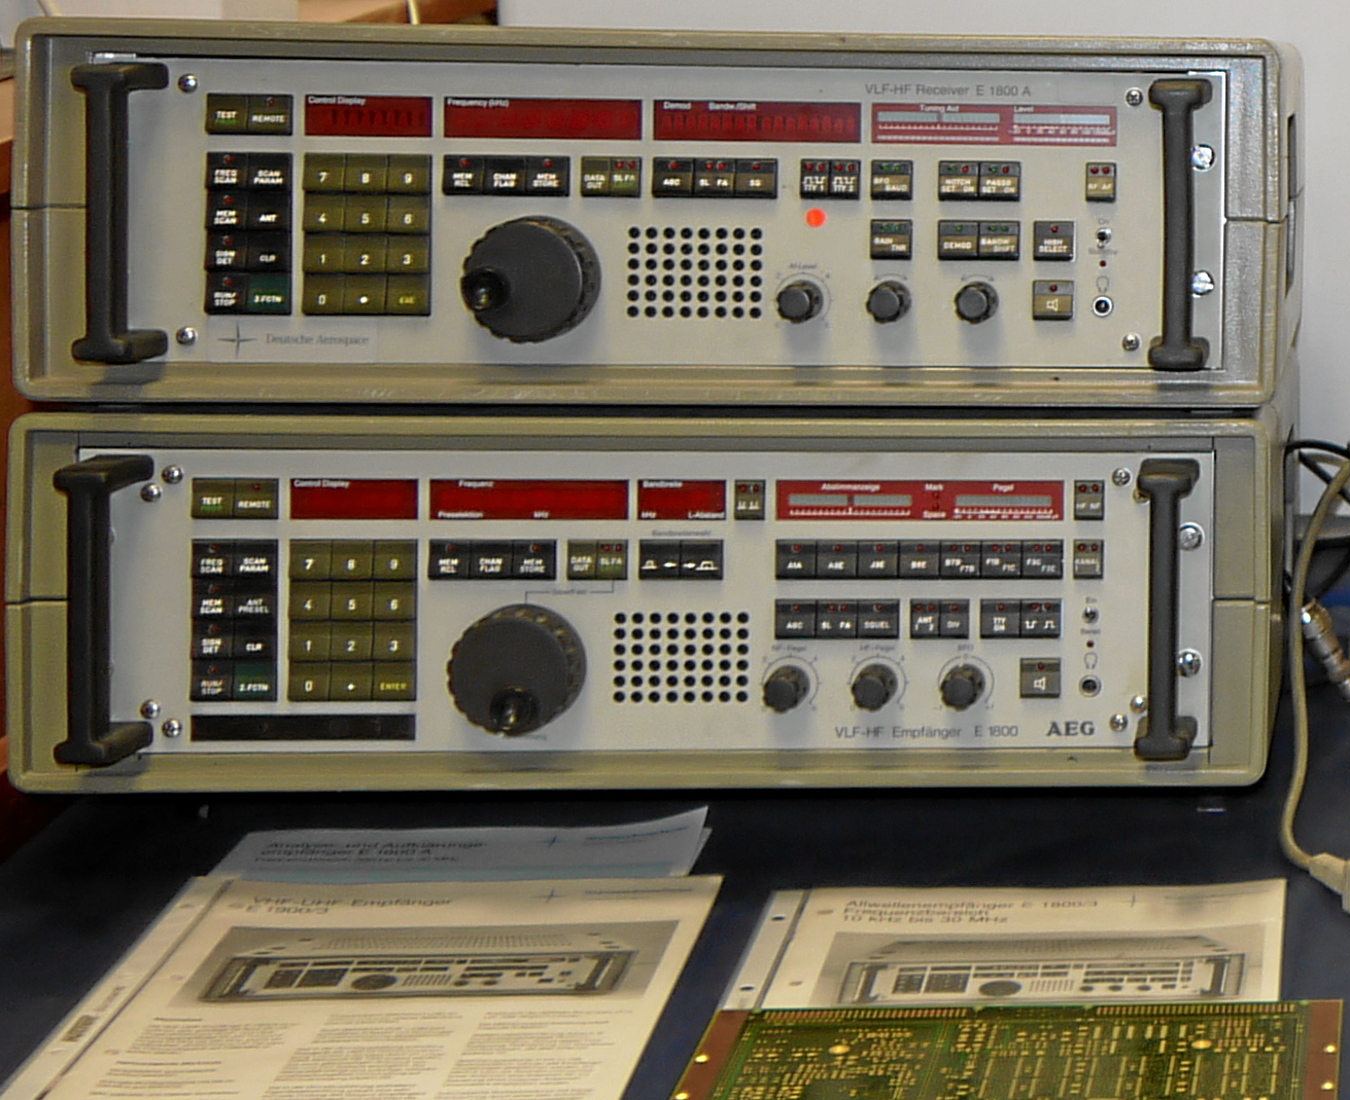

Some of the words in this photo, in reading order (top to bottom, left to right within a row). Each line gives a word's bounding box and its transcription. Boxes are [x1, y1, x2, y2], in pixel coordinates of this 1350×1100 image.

[864, 84, 912, 96] VLF-HF
[916, 84, 969, 96] Receiver
[976, 86, 985, 96] E
[987, 86, 1018, 97] 1800
[1019, 86, 1031, 97] A
[307, 96, 336, 105] Control
[337, 96, 366, 106] Display
[217, 110, 237, 119] TEST
[252, 114, 285, 123] REMOTE
[294, 480, 322, 488] Control
[322, 480, 350, 489] Display
[202, 497, 223, 505] TEST
[238, 500, 271, 509] REMOTE
[835, 725, 884, 738] VLF-HF
[892, 725, 962, 741] Empfänger
[974, 726, 983, 737] E
[987, 725, 1019, 738] 1800
[1046, 721, 1095, 737] AEG
[350, 897, 453, 908] Empfänger
